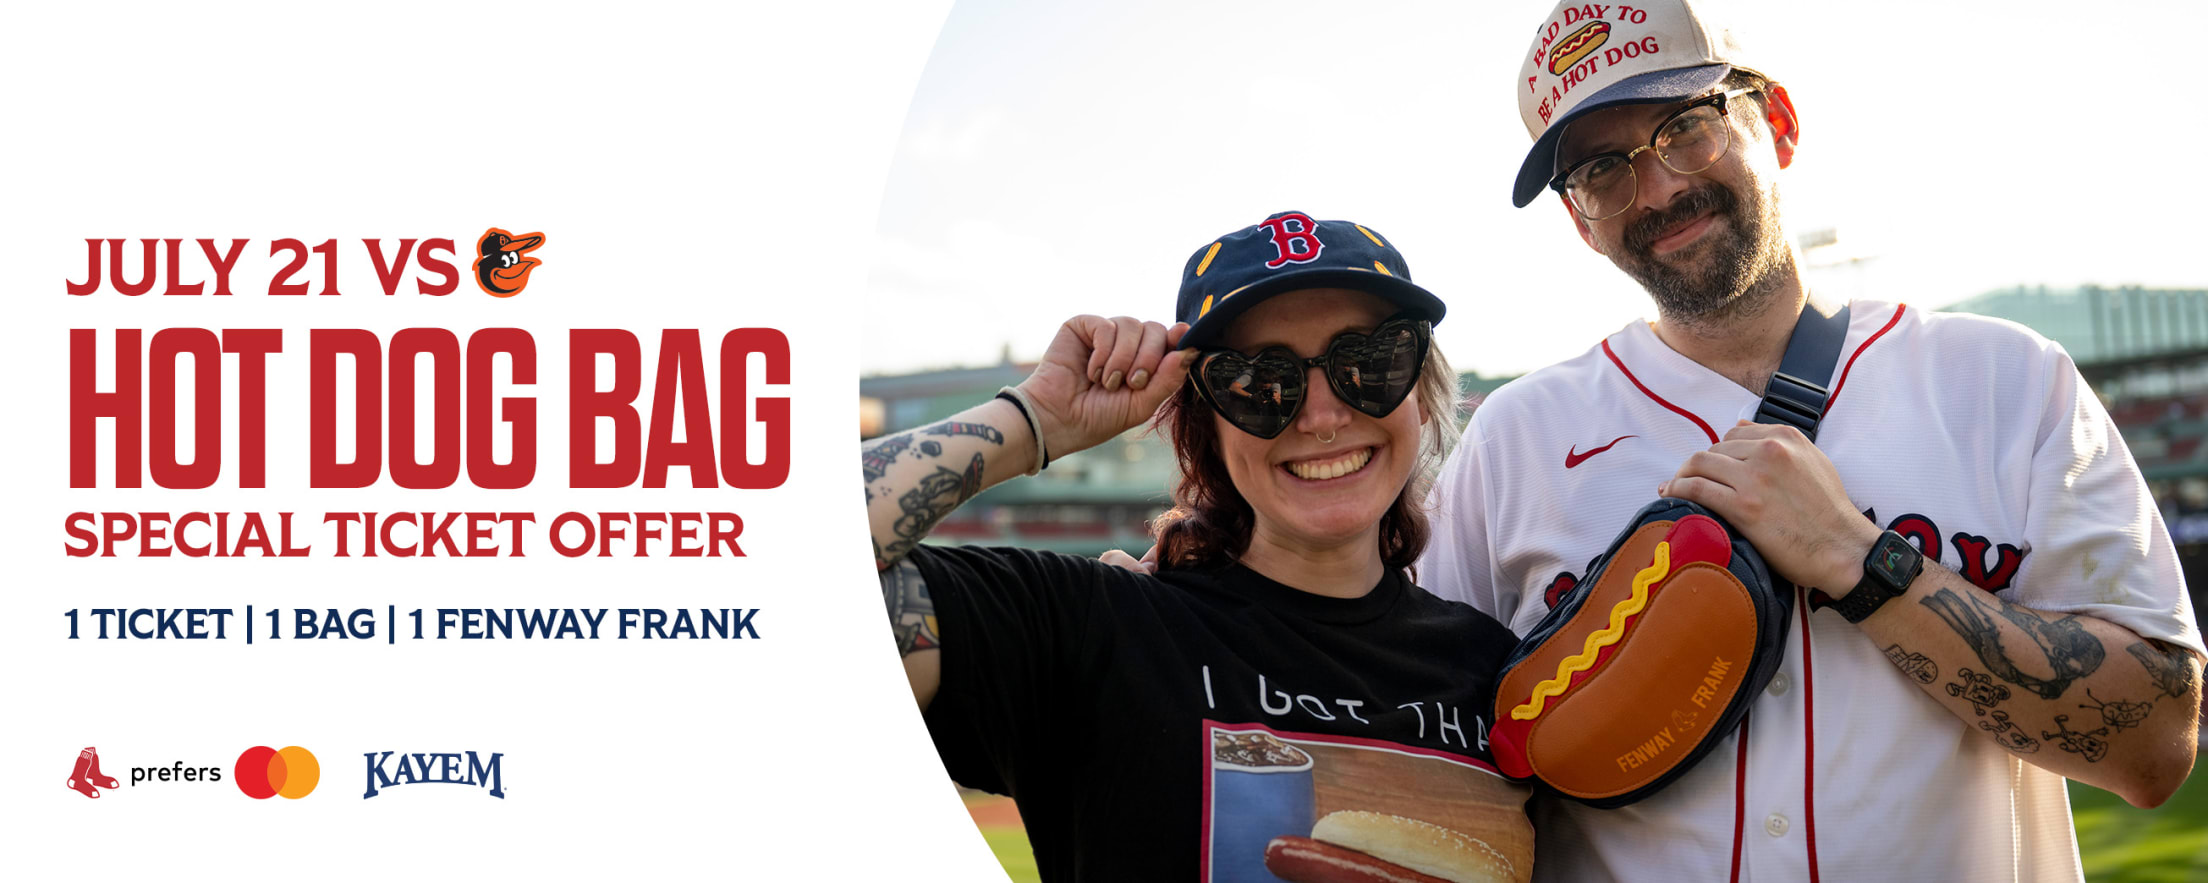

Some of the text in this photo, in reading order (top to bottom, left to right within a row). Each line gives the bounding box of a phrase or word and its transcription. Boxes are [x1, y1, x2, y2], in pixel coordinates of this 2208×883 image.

[1528, 4, 1647, 94] A BAD DAY TO
[1537, 36, 1660, 127] BE A HOT DOG
[1257, 213, 1325, 269] B
[1616, 656, 1733, 773] FENWAY FRANK
